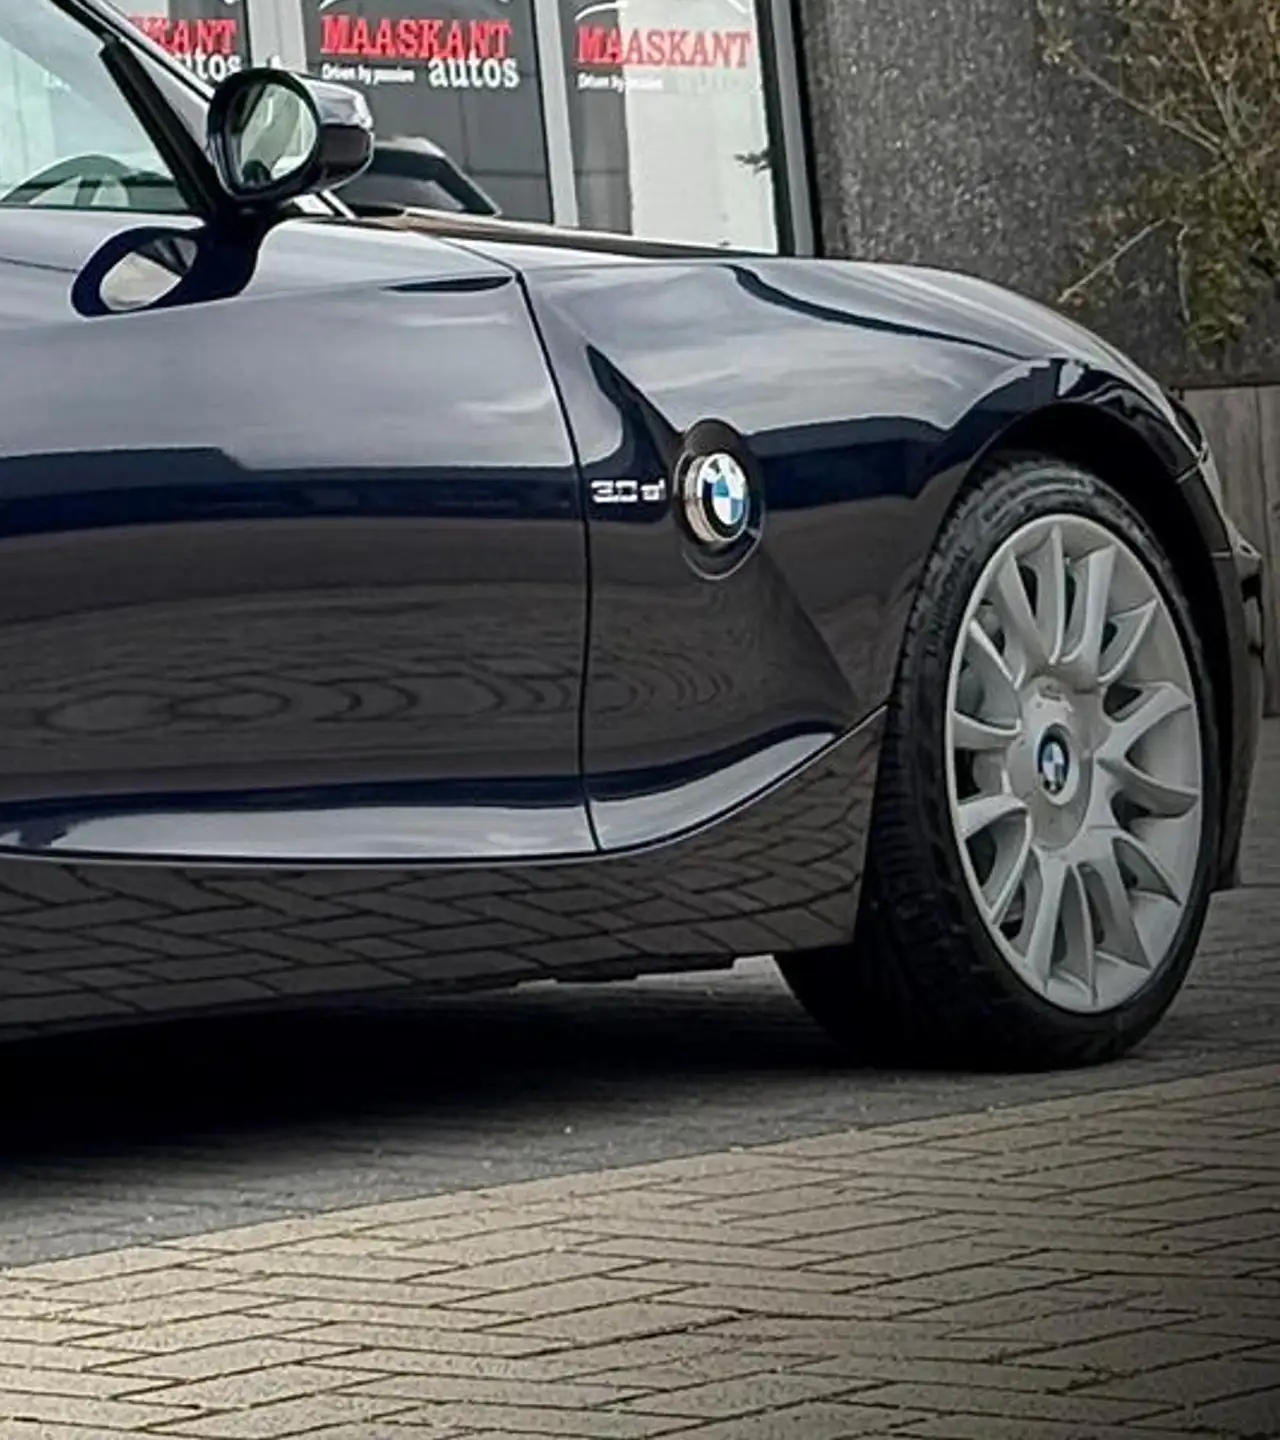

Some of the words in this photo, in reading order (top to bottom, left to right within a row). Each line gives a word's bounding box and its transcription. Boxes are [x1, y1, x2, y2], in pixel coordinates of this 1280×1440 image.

[320, 14, 512, 59] MAASKANT
[575, 25, 752, 69] MAASKANT
[428, 50, 520, 88] autos
